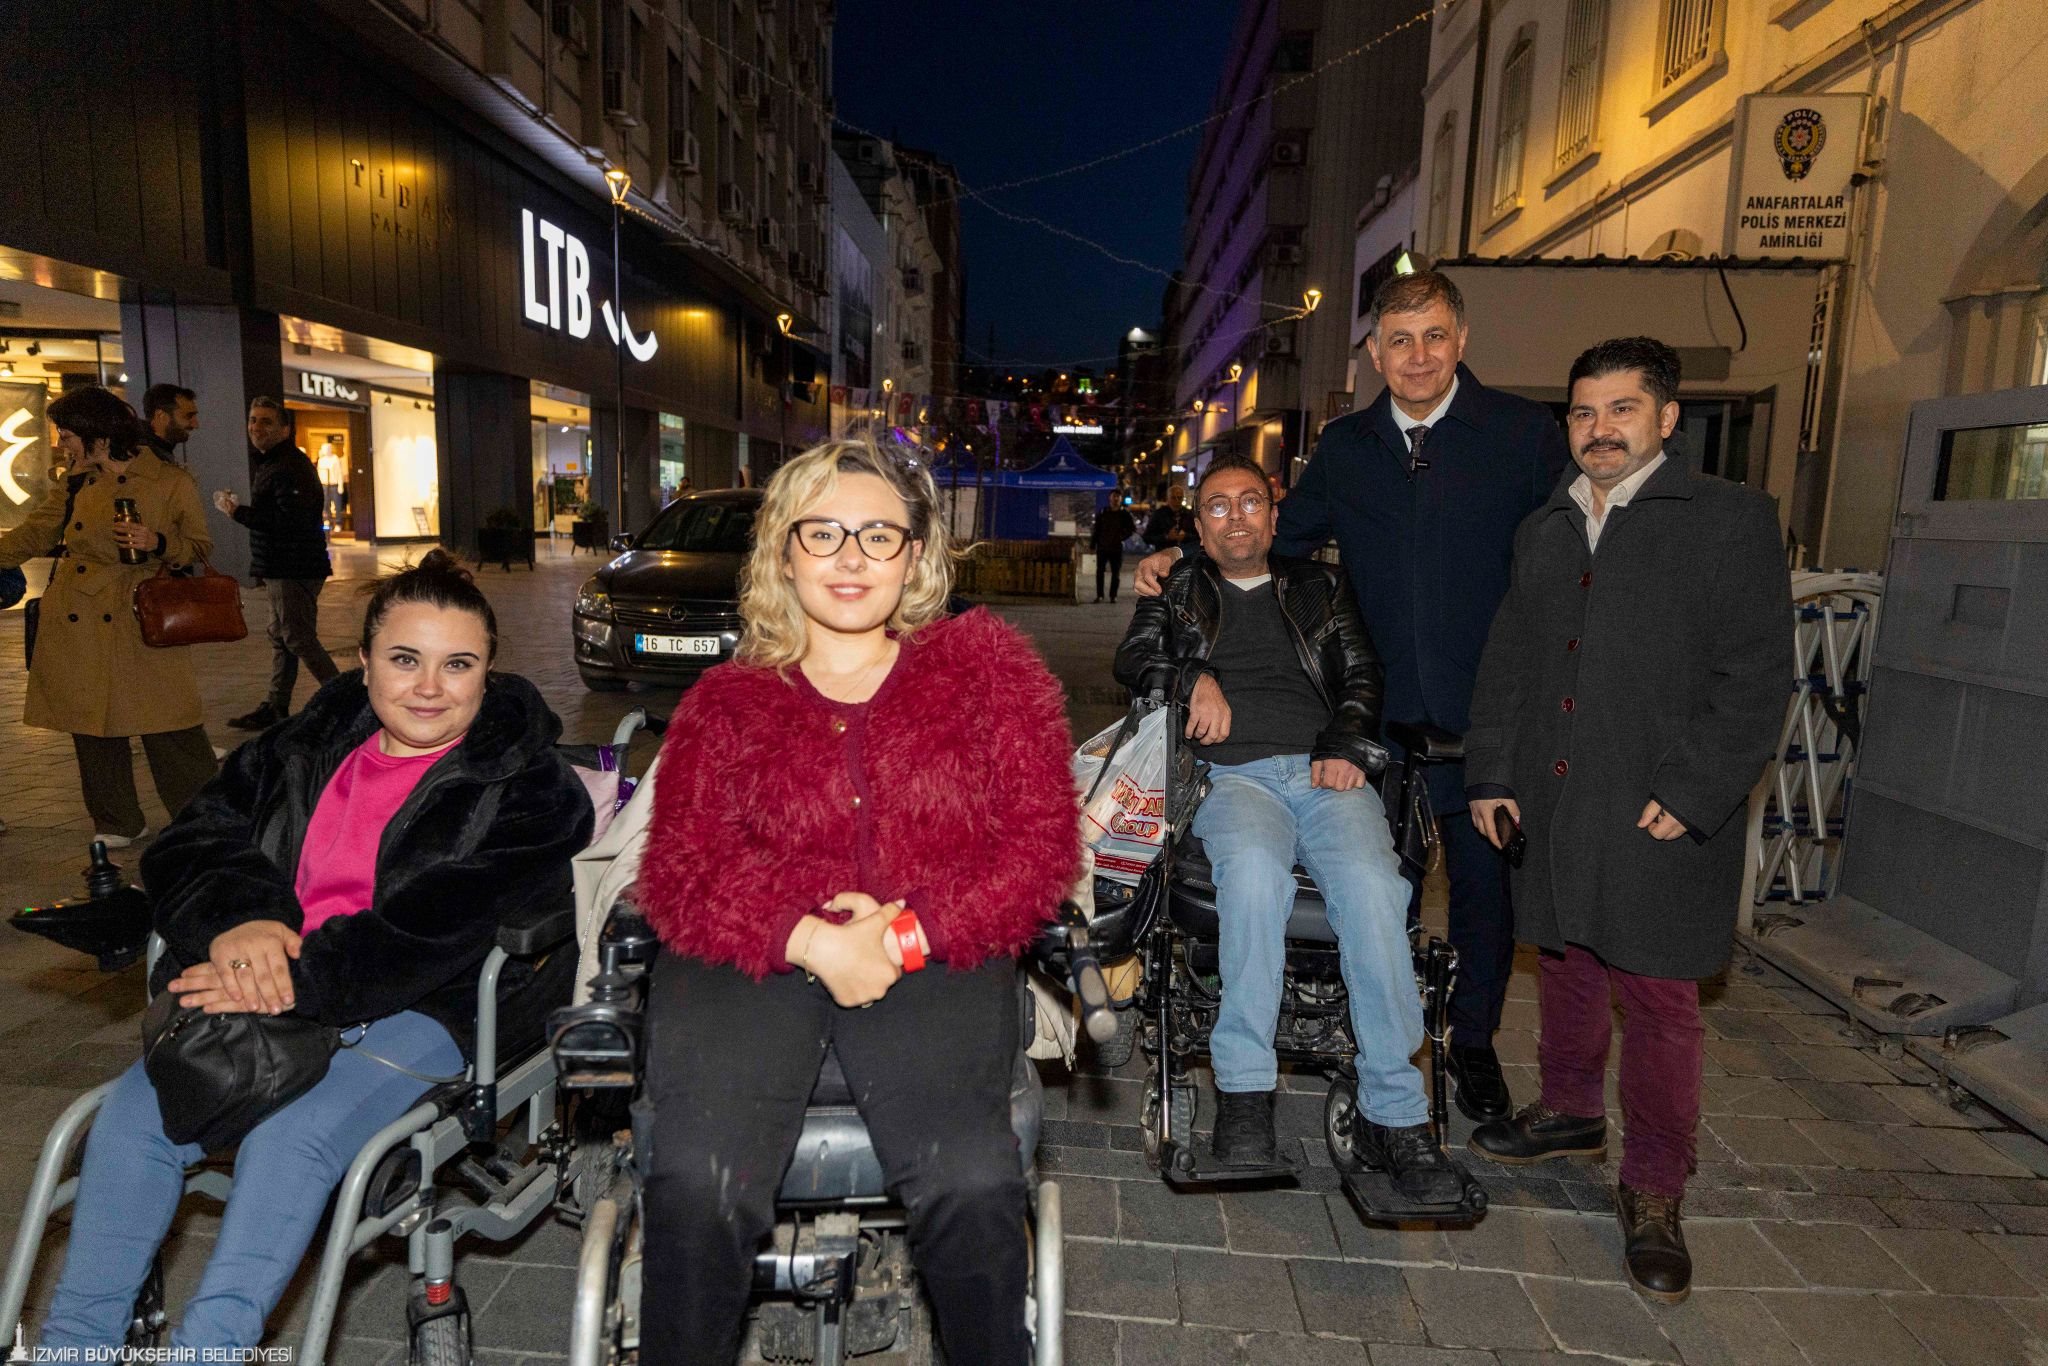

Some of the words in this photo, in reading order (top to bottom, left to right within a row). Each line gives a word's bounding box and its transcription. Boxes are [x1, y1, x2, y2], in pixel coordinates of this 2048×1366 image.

[1746, 195, 1844, 209] ANAFARTALAR
[1740, 213, 1780, 229] POLİS
[1784, 212, 1847, 229] MERKEZİ
[1759, 232, 1824, 248] AMİRLİĞİ
[522, 208, 592, 339] LTB
[301, 372, 336, 398] LTB
[644, 637, 658, 651] 16
[669, 639, 683, 652] TC
[693, 640, 716, 653] 657
[1111, 812, 1159, 838] GROUP
